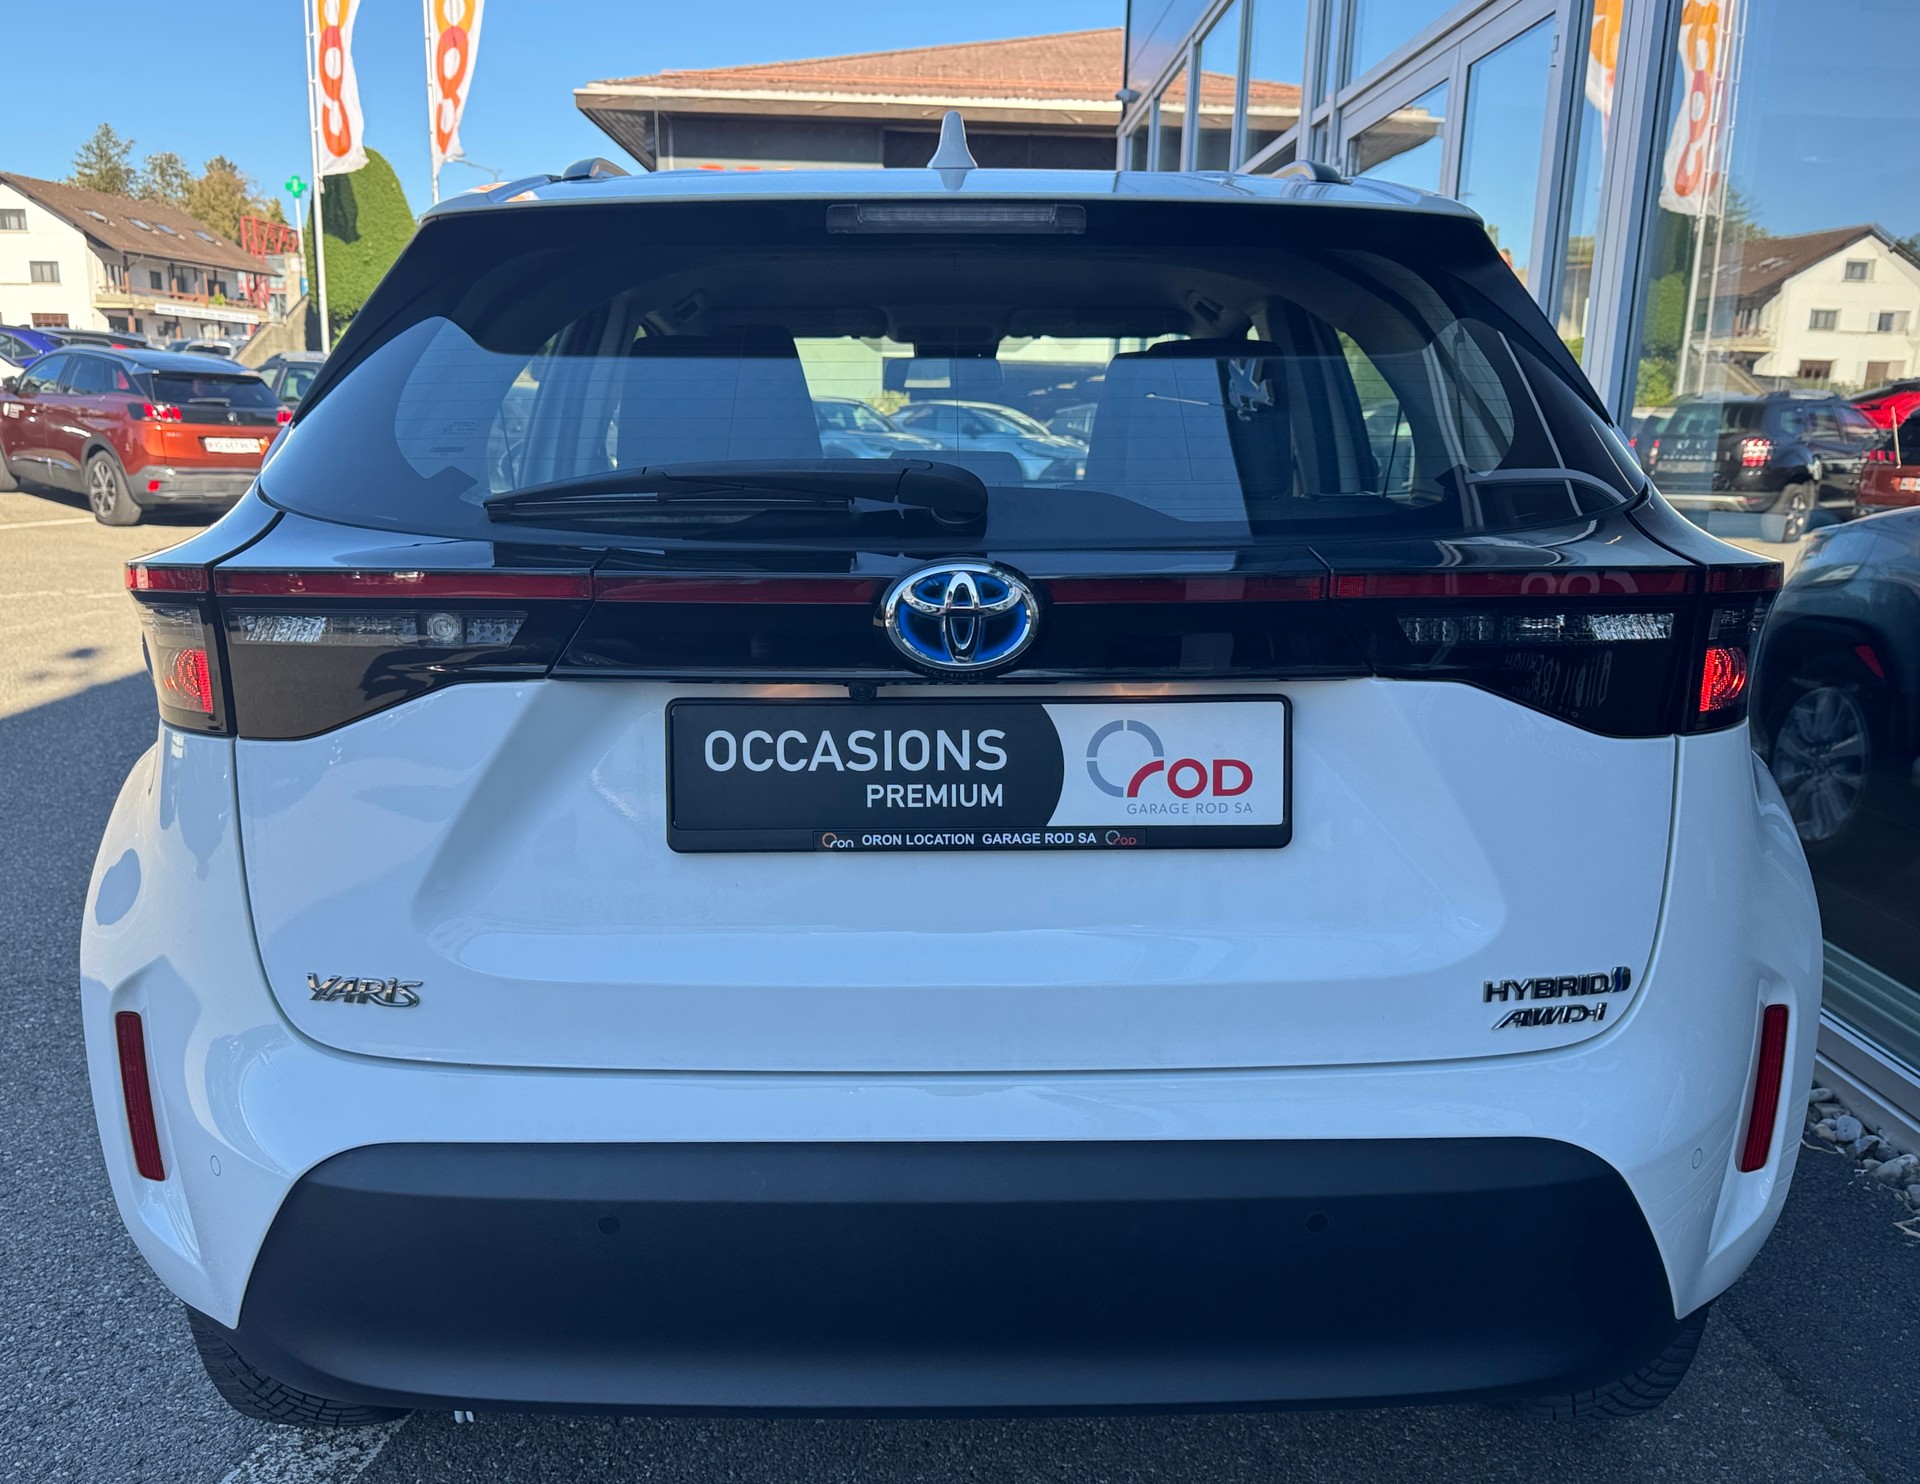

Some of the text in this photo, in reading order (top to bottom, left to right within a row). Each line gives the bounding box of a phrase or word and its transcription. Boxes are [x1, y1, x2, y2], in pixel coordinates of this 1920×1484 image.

[704, 729, 1008, 772] OCCASIONS
[866, 783, 1003, 808] PREMIUM
[1126, 802, 1253, 815] GARAGE ROD SA
[861, 834, 902, 846] ORON
[905, 833, 975, 846] LOCATION
[982, 833, 1041, 845] GARAGE
[1044, 832, 1075, 844] ROD
[1078, 832, 1097, 844] SA
[1482, 972, 1612, 1003] HYBRID
